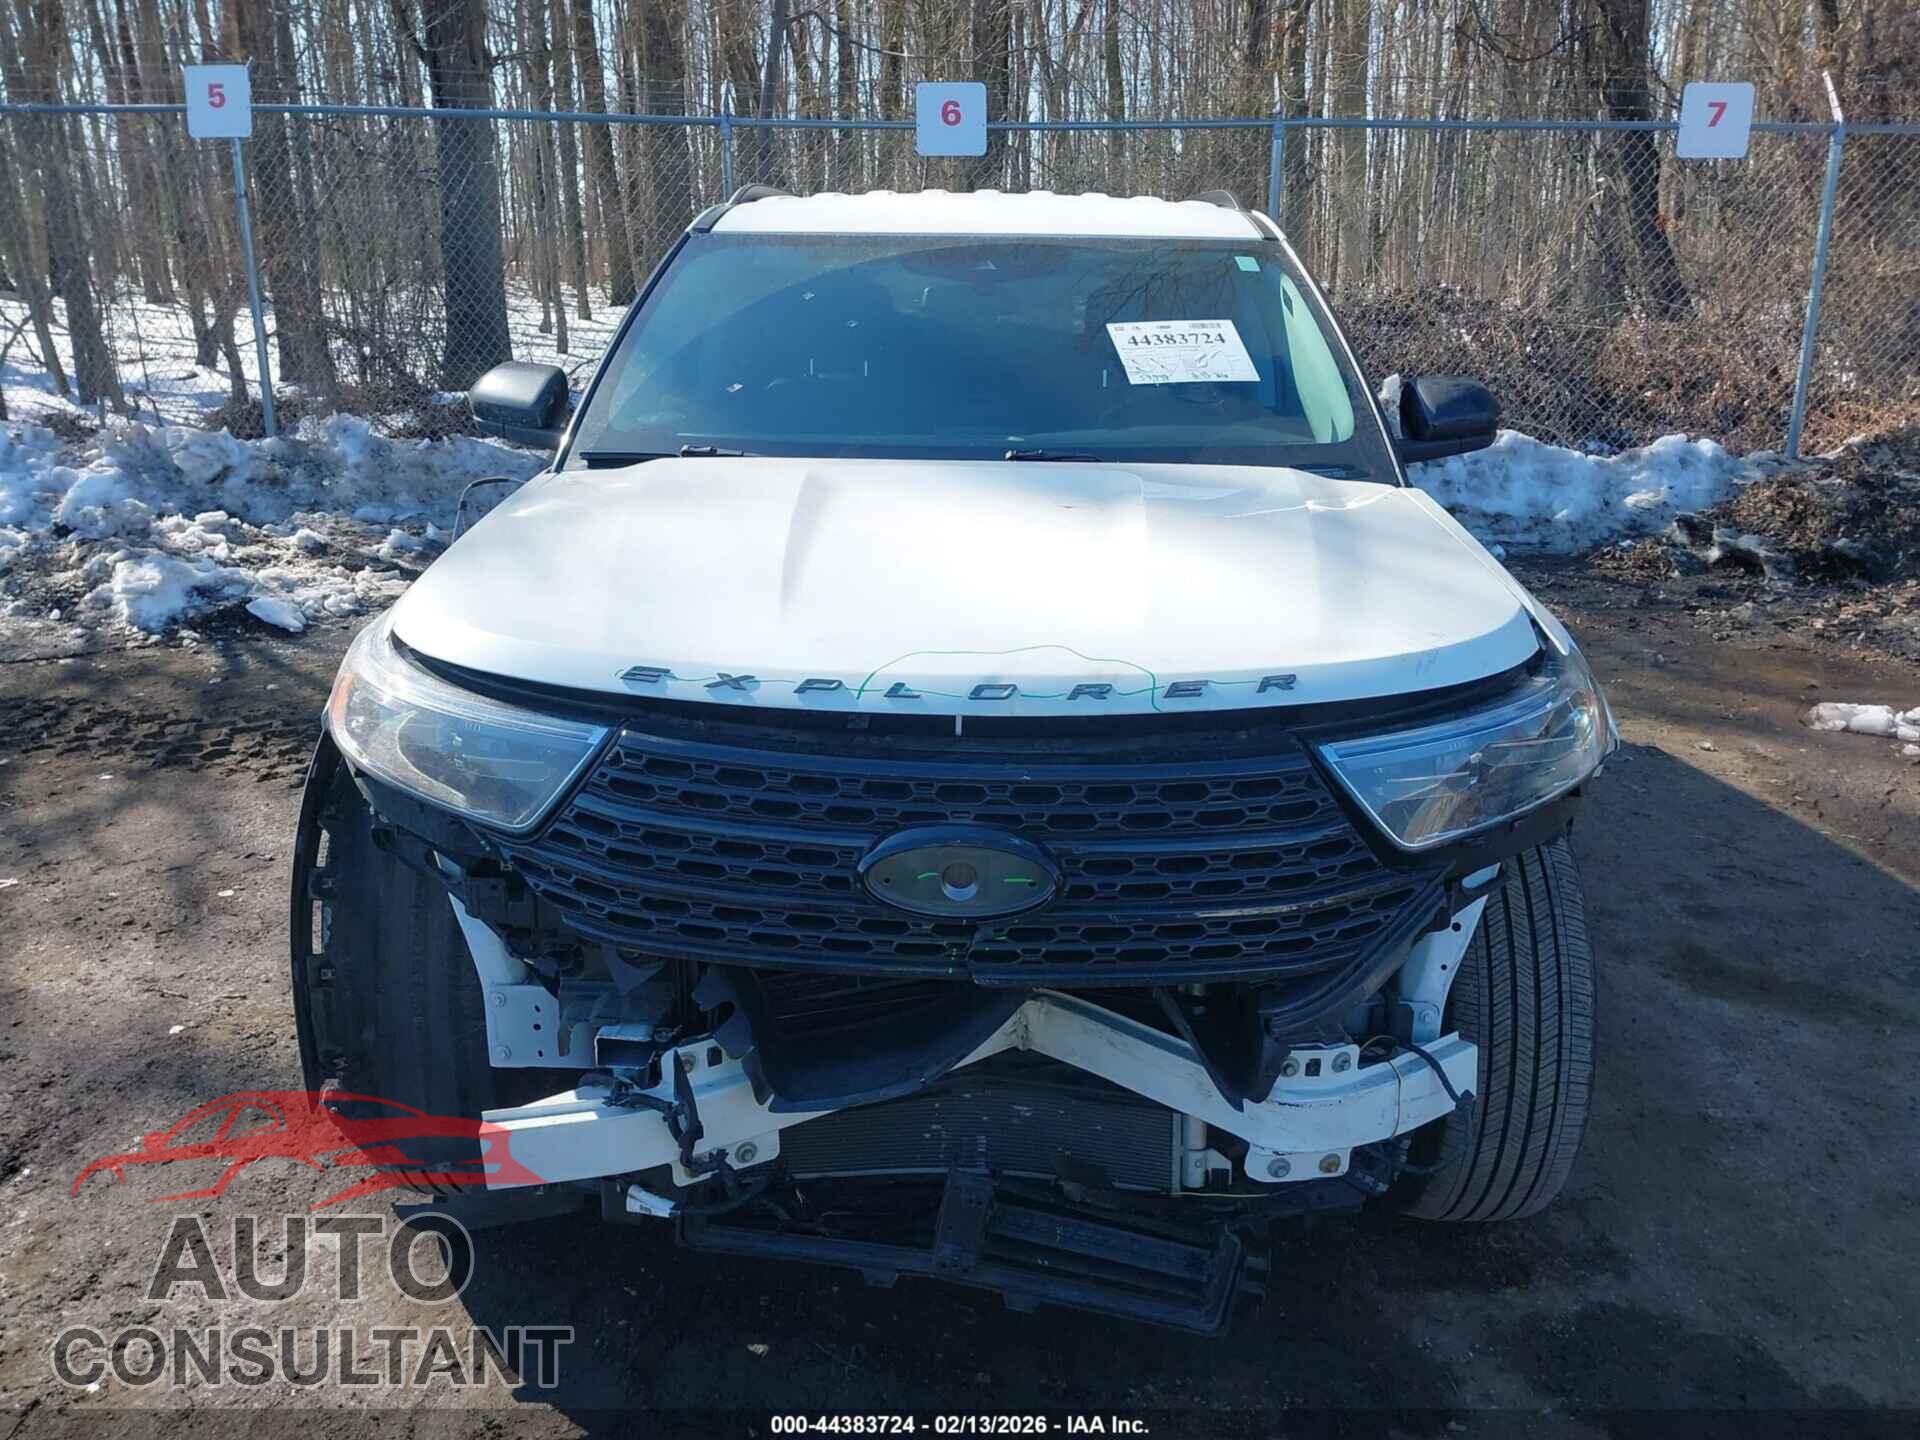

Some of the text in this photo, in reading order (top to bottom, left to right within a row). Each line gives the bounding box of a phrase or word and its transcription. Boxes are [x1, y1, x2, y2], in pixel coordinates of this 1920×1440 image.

[207, 83, 225, 108] 5
[942, 100, 961, 126] 6
[1708, 102, 1727, 127] 7
[1127, 332, 1226, 346] 44383724
[620, 665, 1297, 701] EXPLORER
